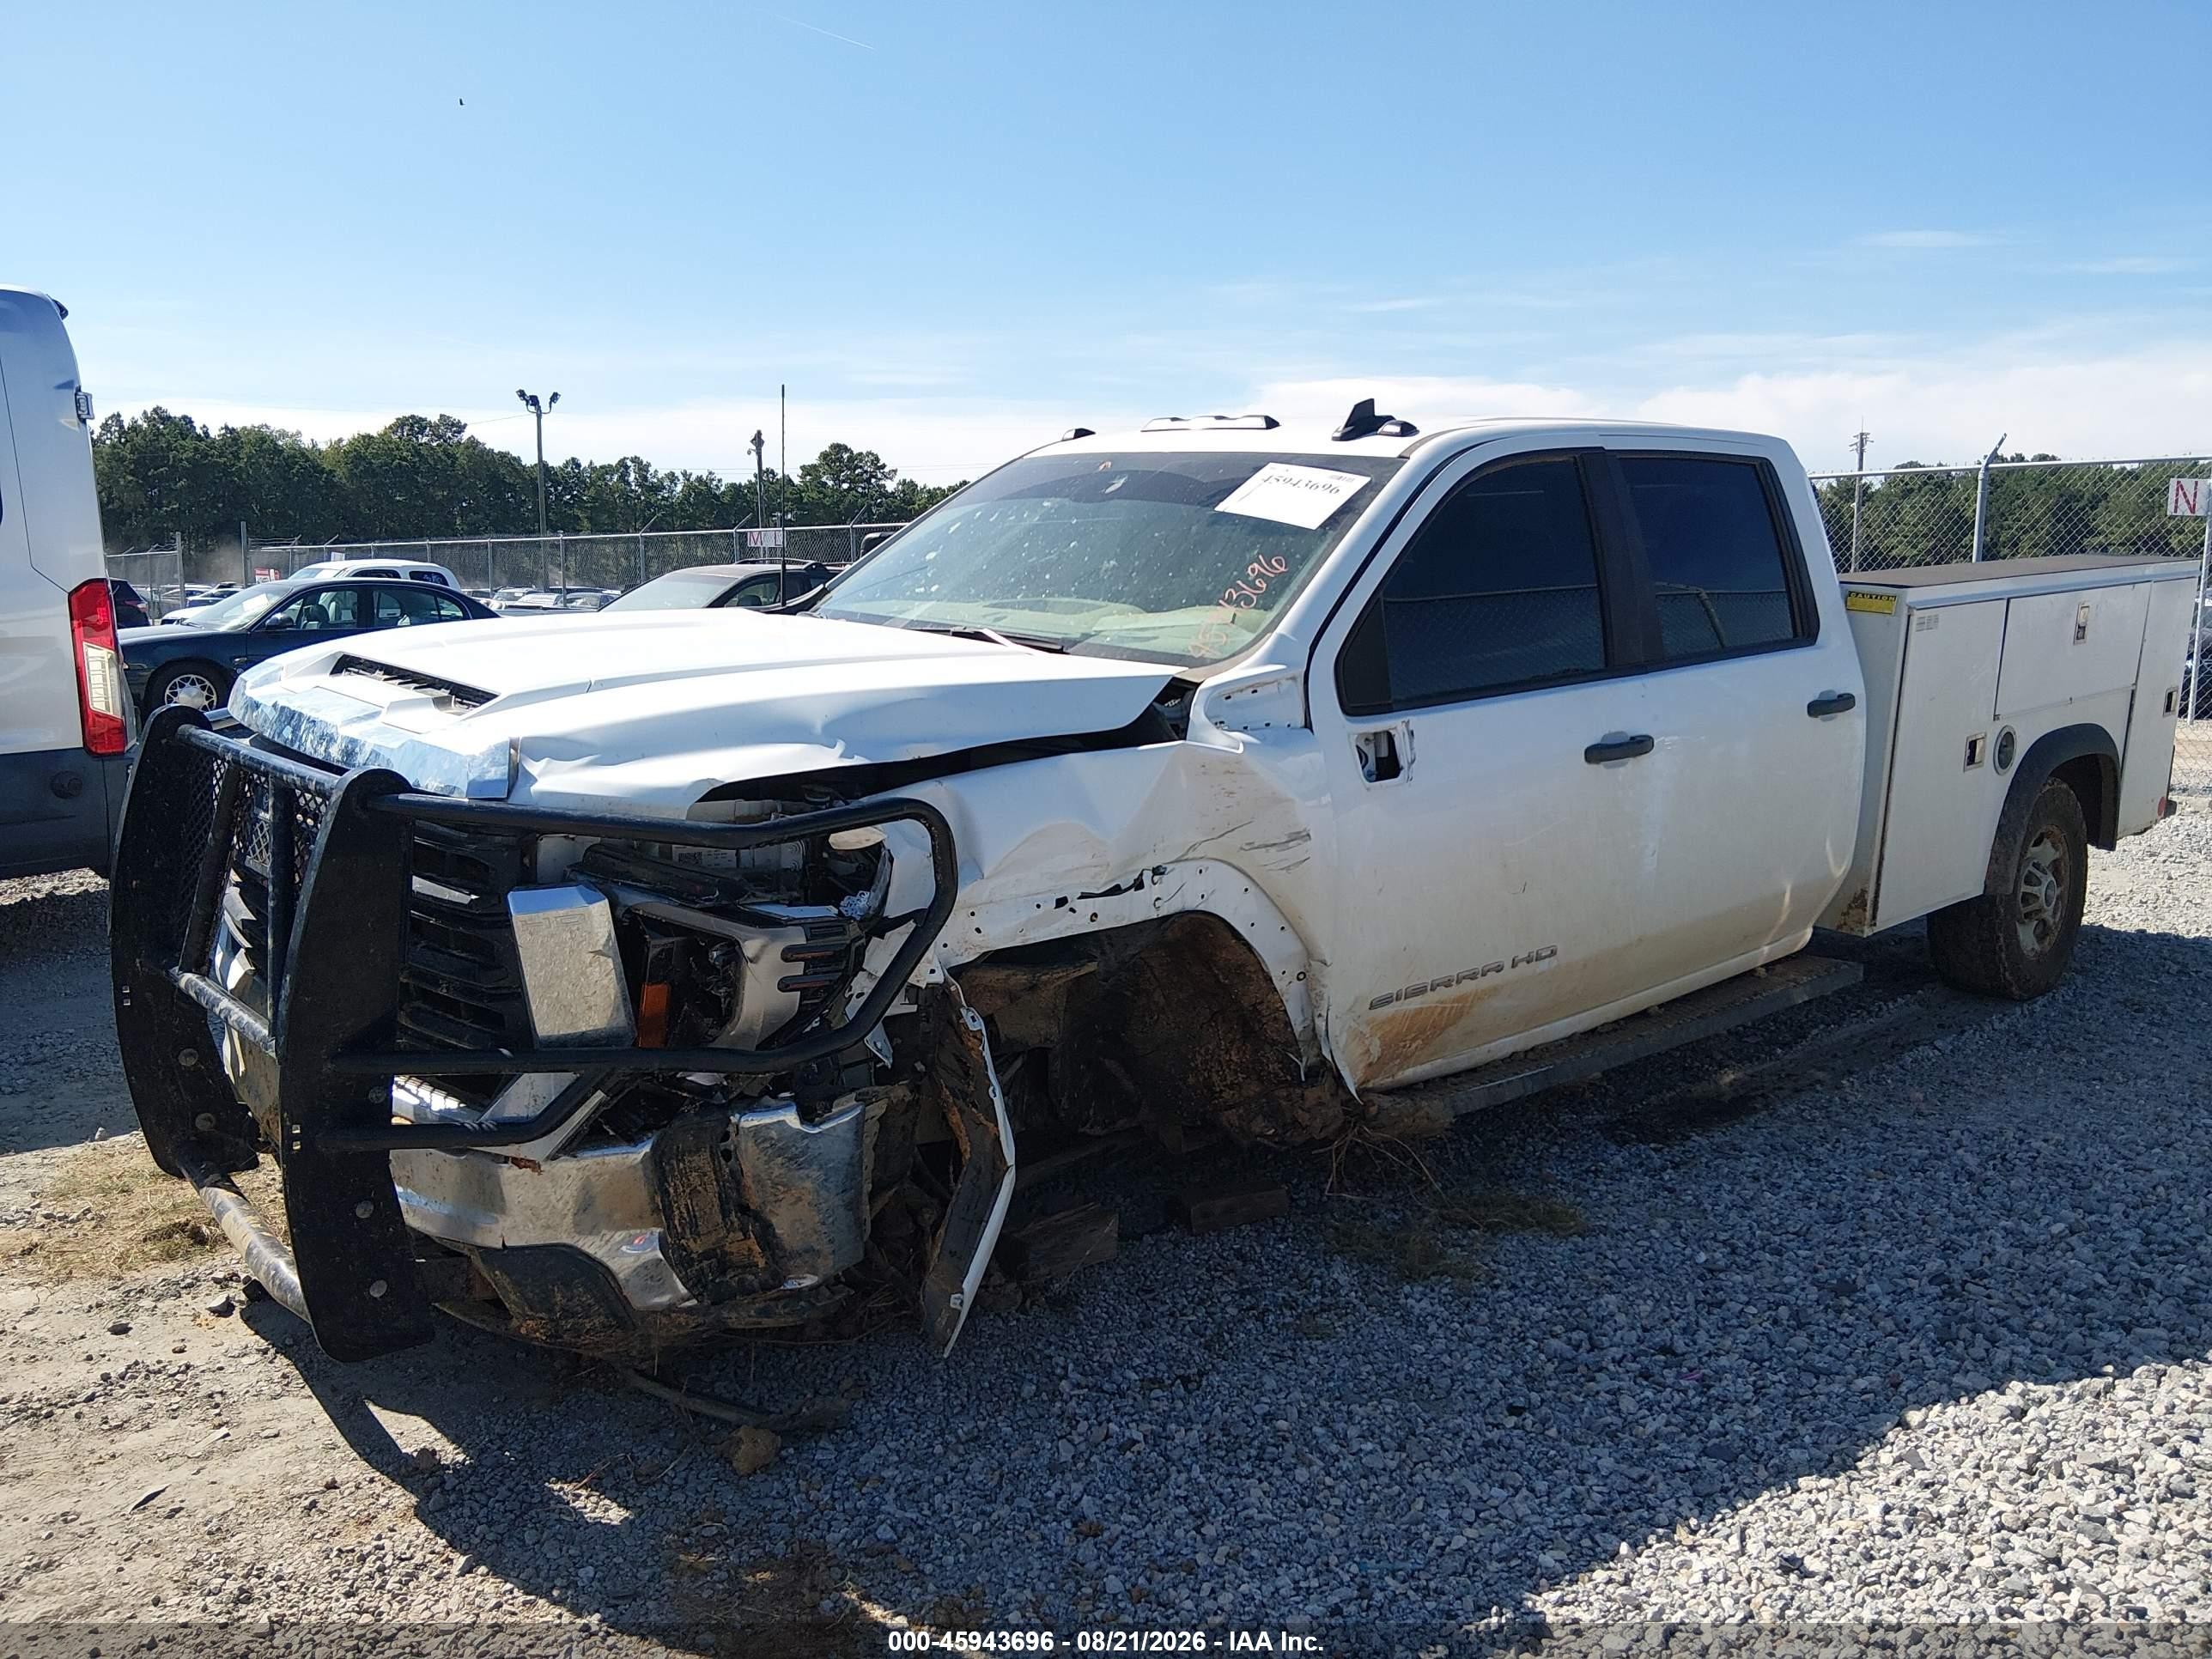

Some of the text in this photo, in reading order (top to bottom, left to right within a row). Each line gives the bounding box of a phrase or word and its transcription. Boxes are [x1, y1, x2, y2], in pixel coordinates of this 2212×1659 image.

[1262, 475, 1340, 495] 45943696
[2173, 480, 2199, 514] N
[749, 532, 763, 546] M
[1850, 592, 1896, 601] CAUTION
[1369, 945, 1559, 1011] SIERRA HD
